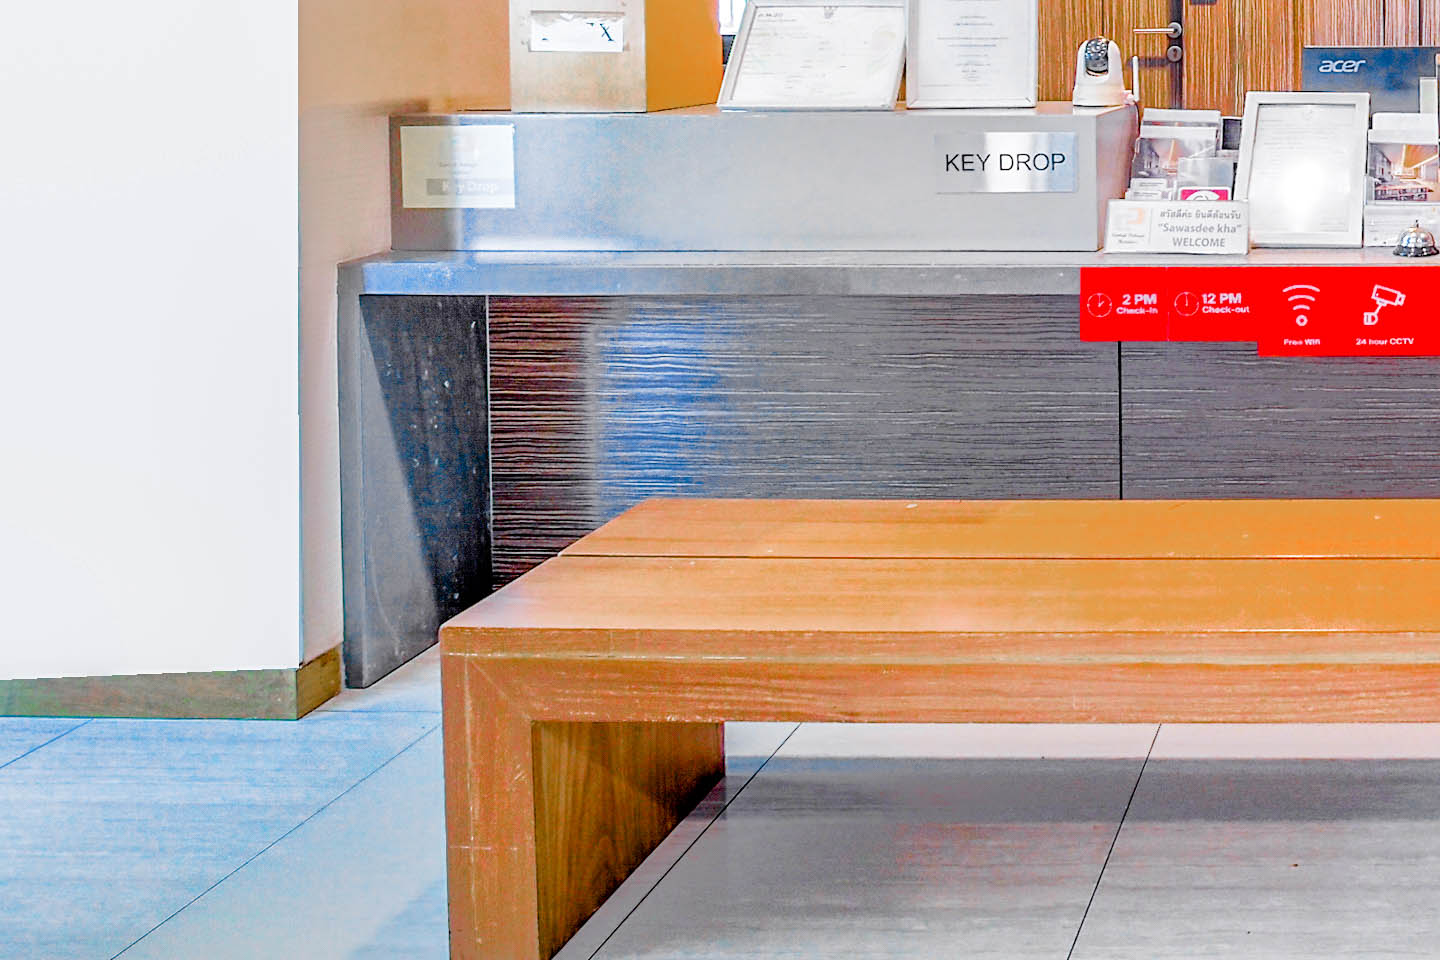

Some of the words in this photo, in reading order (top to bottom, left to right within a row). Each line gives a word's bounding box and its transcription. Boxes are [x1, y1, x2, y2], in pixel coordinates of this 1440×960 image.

[1318, 59, 1366, 73] acer
[945, 153, 991, 172] KEY
[999, 152, 1066, 172] DROP
[1172, 237, 1226, 248] WELCOME
[1122, 293, 1132, 306] 2
[1134, 293, 1158, 306] PM
[1201, 292, 1217, 305] 12
[1219, 292, 1242, 305] PM
[1201, 305, 1250, 314] Check-out
[1283, 338, 1304, 346] Free
[1389, 337, 1415, 345] CCTV
